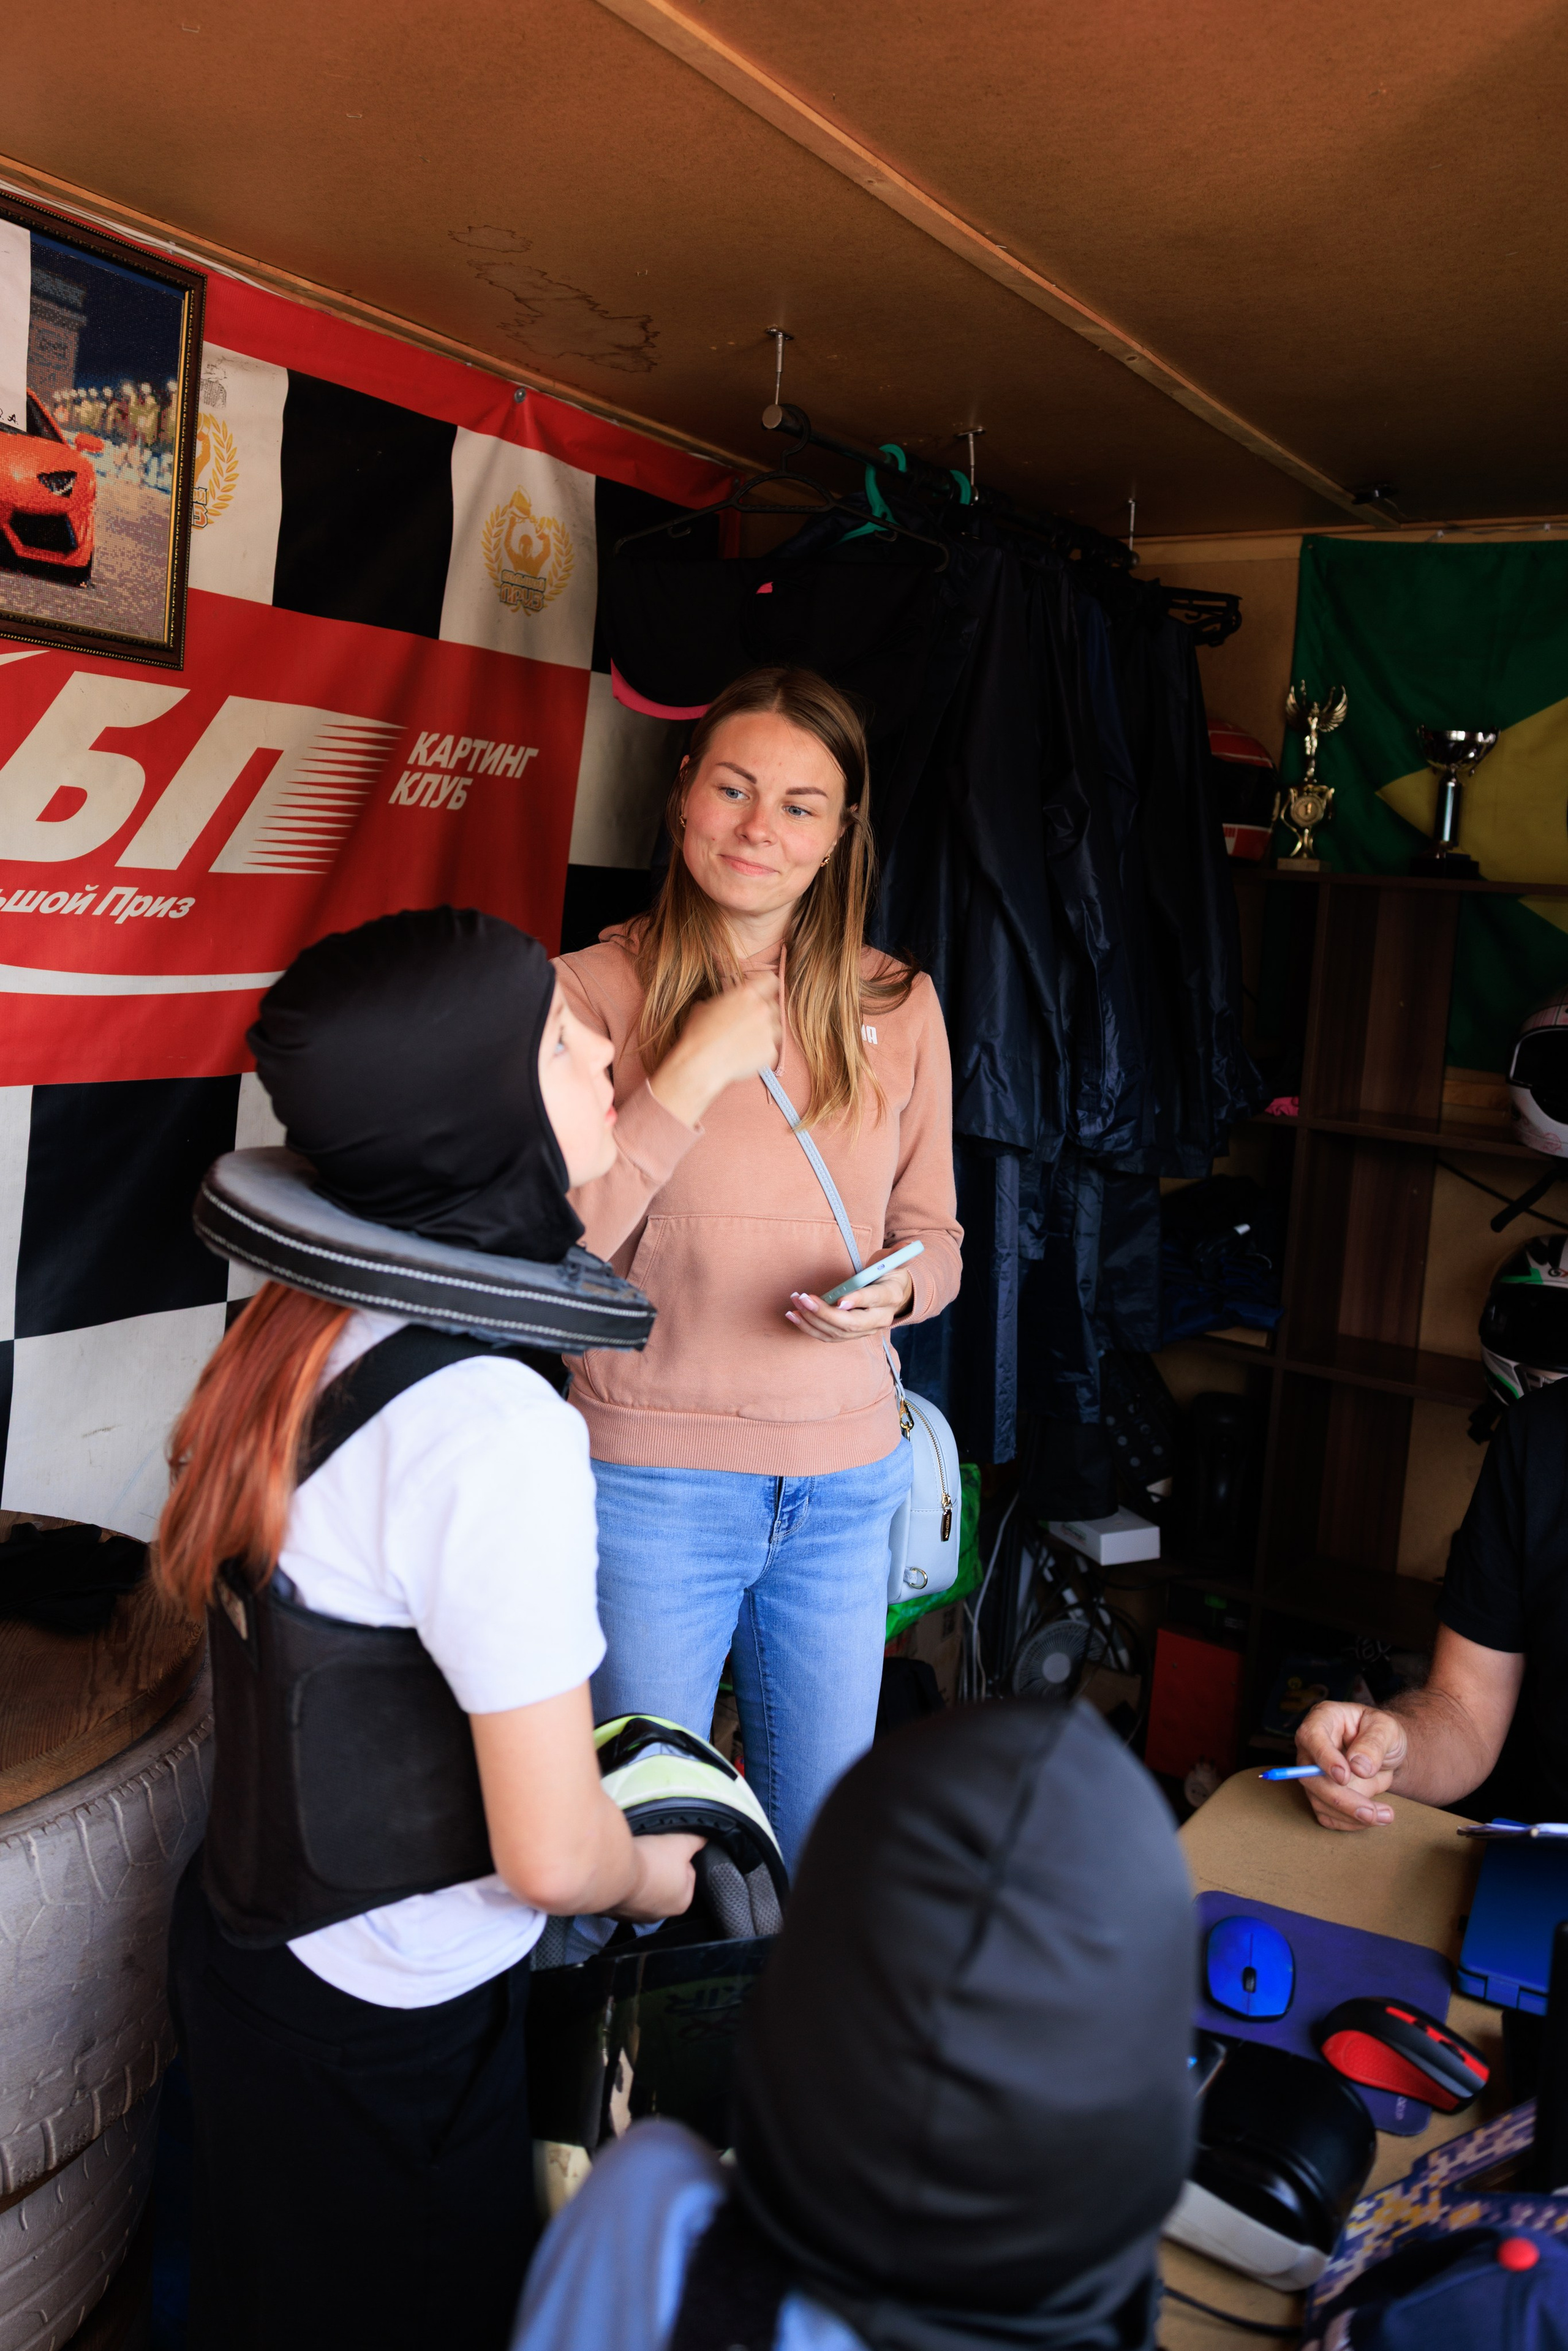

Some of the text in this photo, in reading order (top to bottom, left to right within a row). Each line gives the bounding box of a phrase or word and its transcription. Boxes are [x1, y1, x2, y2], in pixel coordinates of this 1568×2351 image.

[407, 731, 539, 779] КАРТИНГ
[388, 771, 473, 810] КЛУБ
[0, 884, 196, 924] шой Приз
